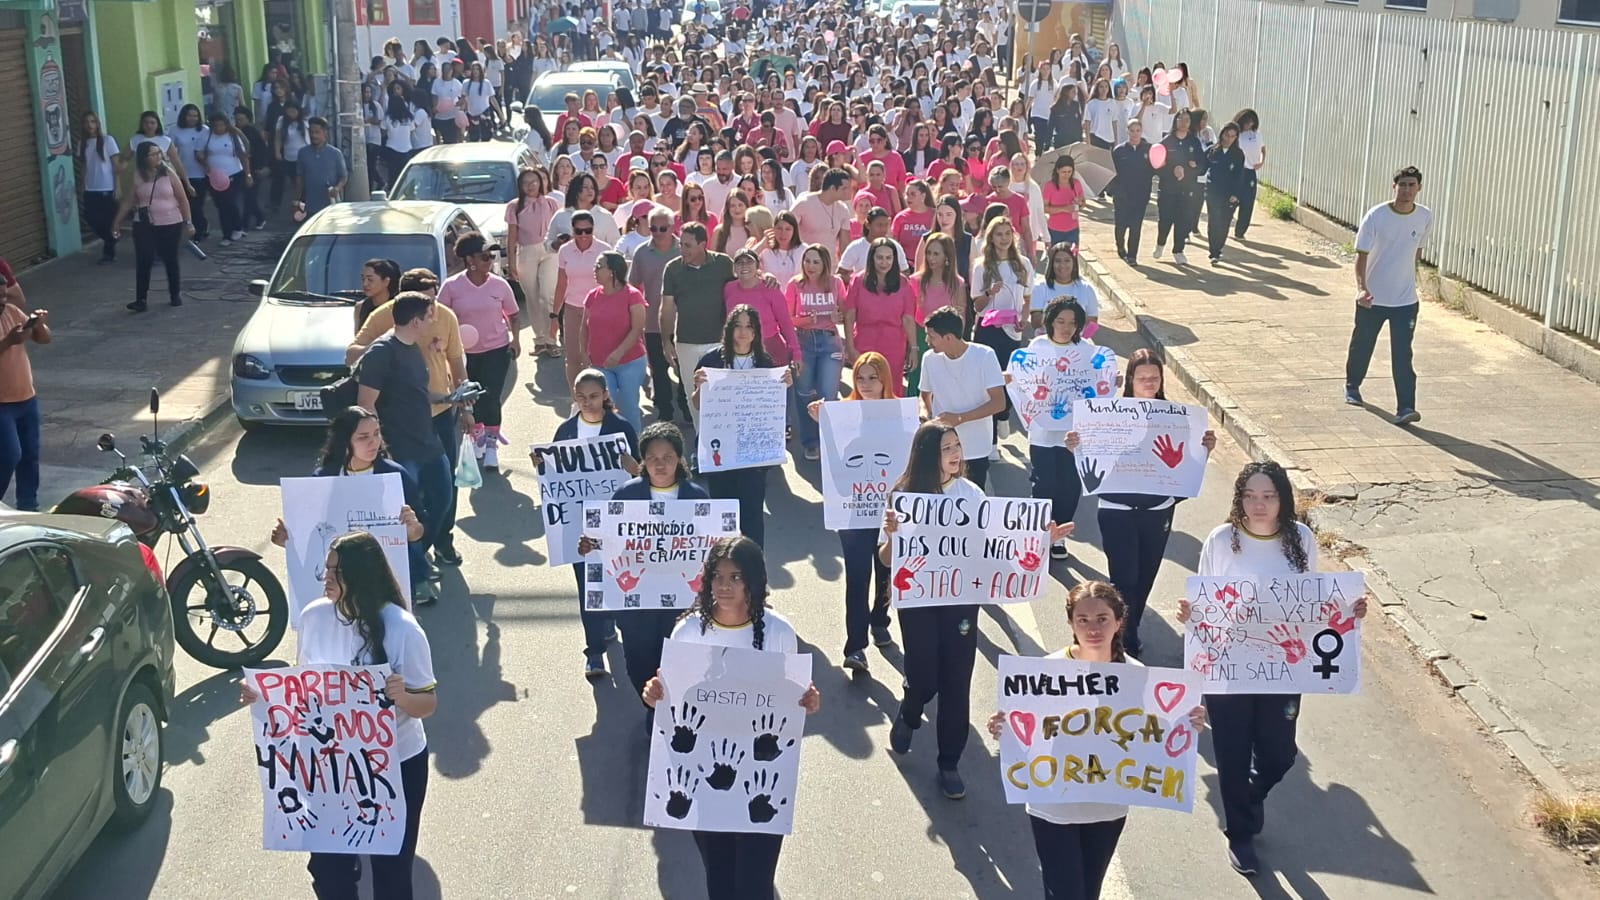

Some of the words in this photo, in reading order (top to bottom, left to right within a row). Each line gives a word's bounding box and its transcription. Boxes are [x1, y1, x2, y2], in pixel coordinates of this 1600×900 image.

[800, 292, 835, 305] VILELA
[1139, 401, 1190, 420] Mundial
[534, 437, 627, 475] MULHER
[541, 479, 617, 498] AFASTA-SE
[852, 493, 862, 501] SE
[547, 502, 570, 525] DE
[895, 496, 970, 527] SOMOS
[978, 500, 991, 529] O
[1004, 500, 1050, 531] GRITO
[626, 537, 651, 550] NÃO
[898, 536, 930, 558] DAS
[939, 535, 970, 557] QUE
[984, 535, 1016, 561] NÃO
[990, 571, 1041, 598] AQUI
[1192, 582, 1212, 603] A
[1213, 577, 1346, 603] VIOLÊNCIA
[1189, 626, 1248, 644] ANTES
[1208, 647, 1230, 661] DA
[1246, 661, 1293, 682] SAIA
[255, 670, 375, 707] PAREM
[697, 688, 747, 706] BASTA
[756, 693, 776, 707] DE
[267, 704, 311, 738] DE
[334, 709, 395, 748] NOS
[1042, 706, 1165, 752] FORÇA
[1006, 754, 1185, 803] CORAGEM
